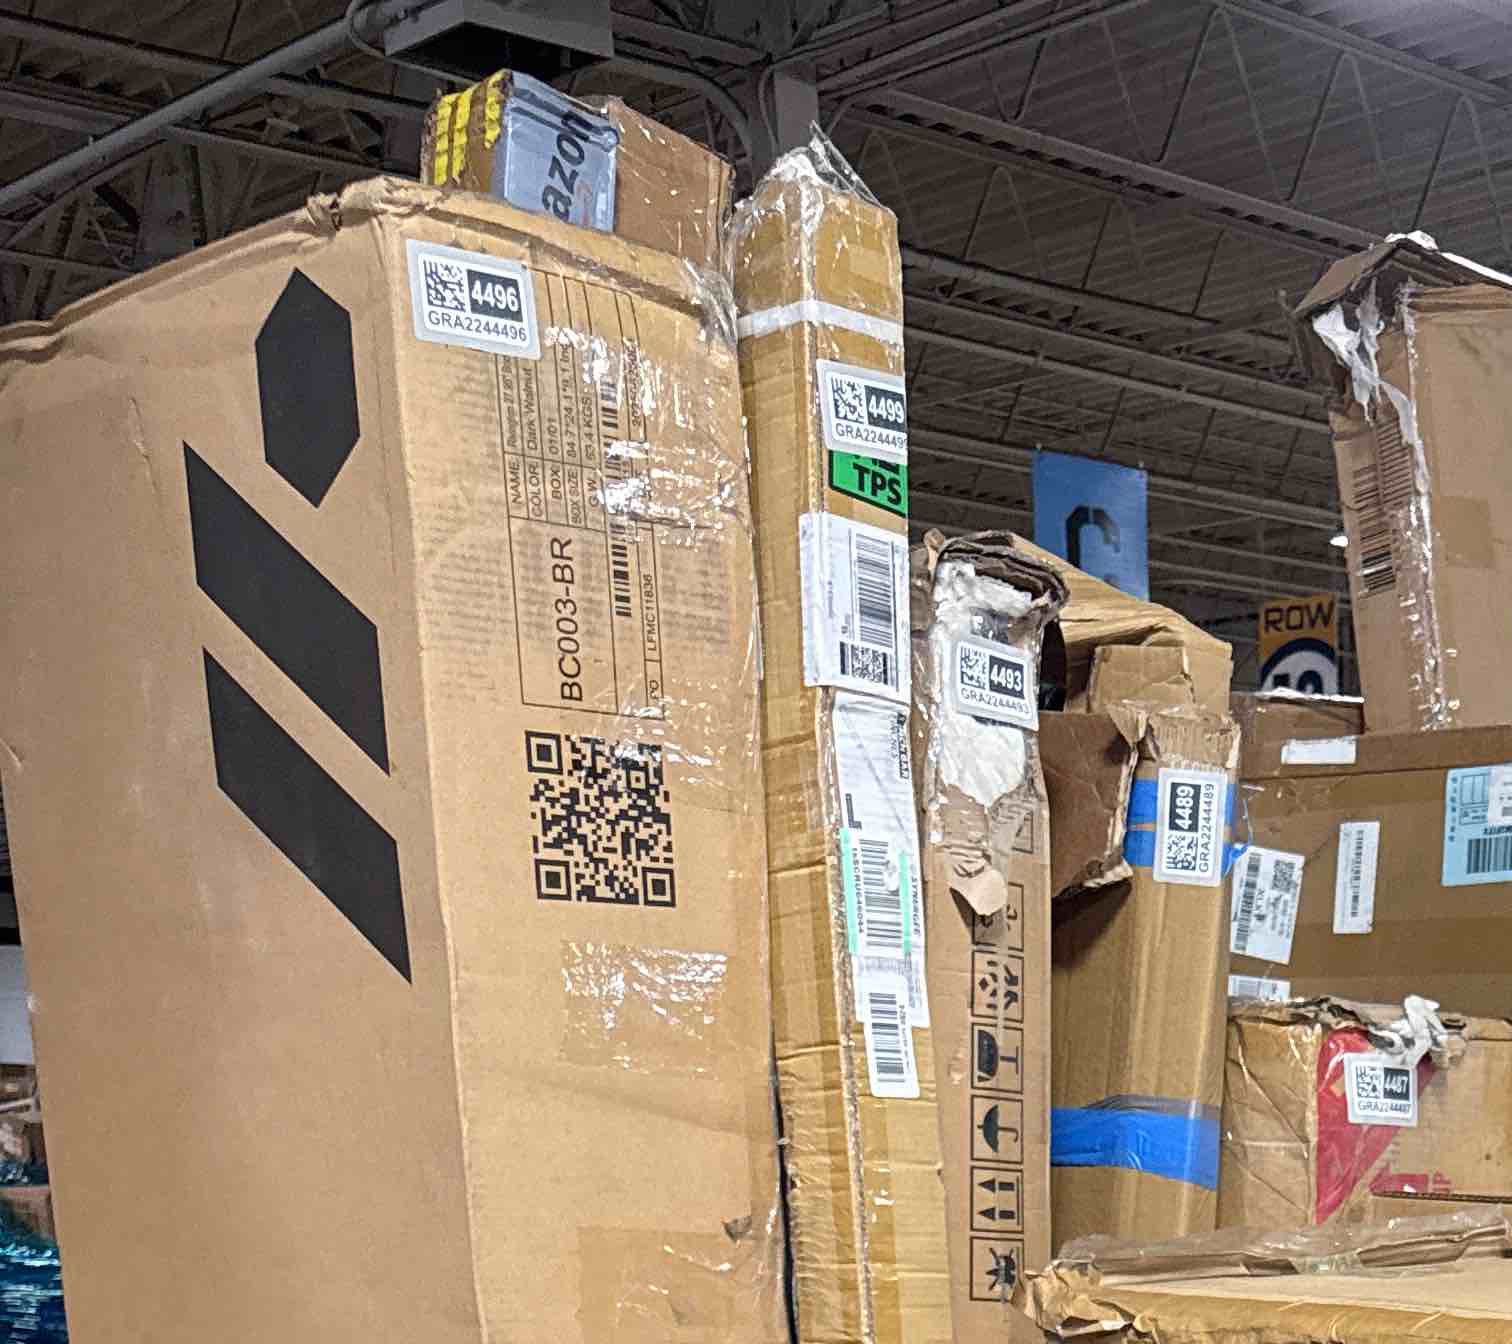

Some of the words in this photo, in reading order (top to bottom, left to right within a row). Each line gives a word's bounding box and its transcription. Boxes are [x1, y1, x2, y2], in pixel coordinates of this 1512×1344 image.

[472, 280, 520, 312] 4496
[428, 309, 528, 341] GRA2244496
[868, 395, 905, 424] 4499
[525, 418, 538, 451] Dark
[547, 417, 559, 455] 01/01
[852, 463, 901, 505] TPS
[551, 537, 583, 701] BC003-BR
[1263, 600, 1336, 635] ROW
[990, 663, 1023, 692] 4493
[1174, 785, 1194, 830] 4489
[1198, 783, 1215, 873] GRA2244489
